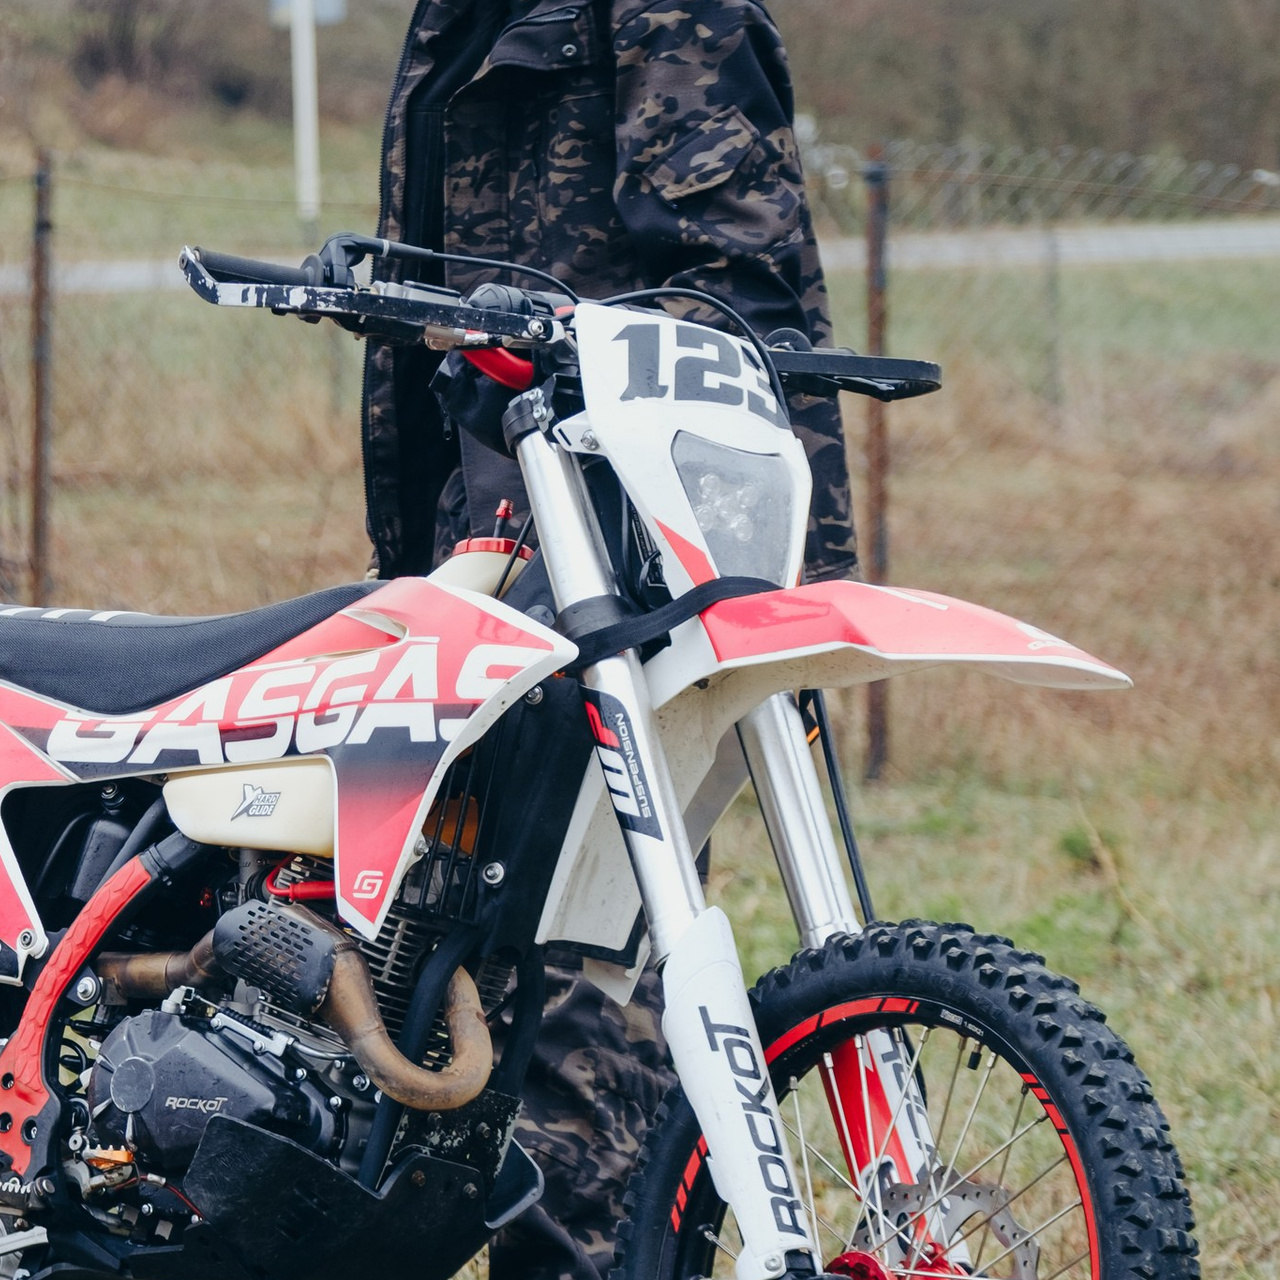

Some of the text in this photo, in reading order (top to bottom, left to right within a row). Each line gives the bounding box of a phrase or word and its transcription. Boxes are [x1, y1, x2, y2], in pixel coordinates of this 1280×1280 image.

[615, 712, 652, 819] SUSPENSION
[253, 793, 280, 805] HARD
[248, 805, 275, 816] GLIDE
[165, 1096, 228, 1113] ROCKOT
[698, 1006, 809, 1240] ROCKOT
